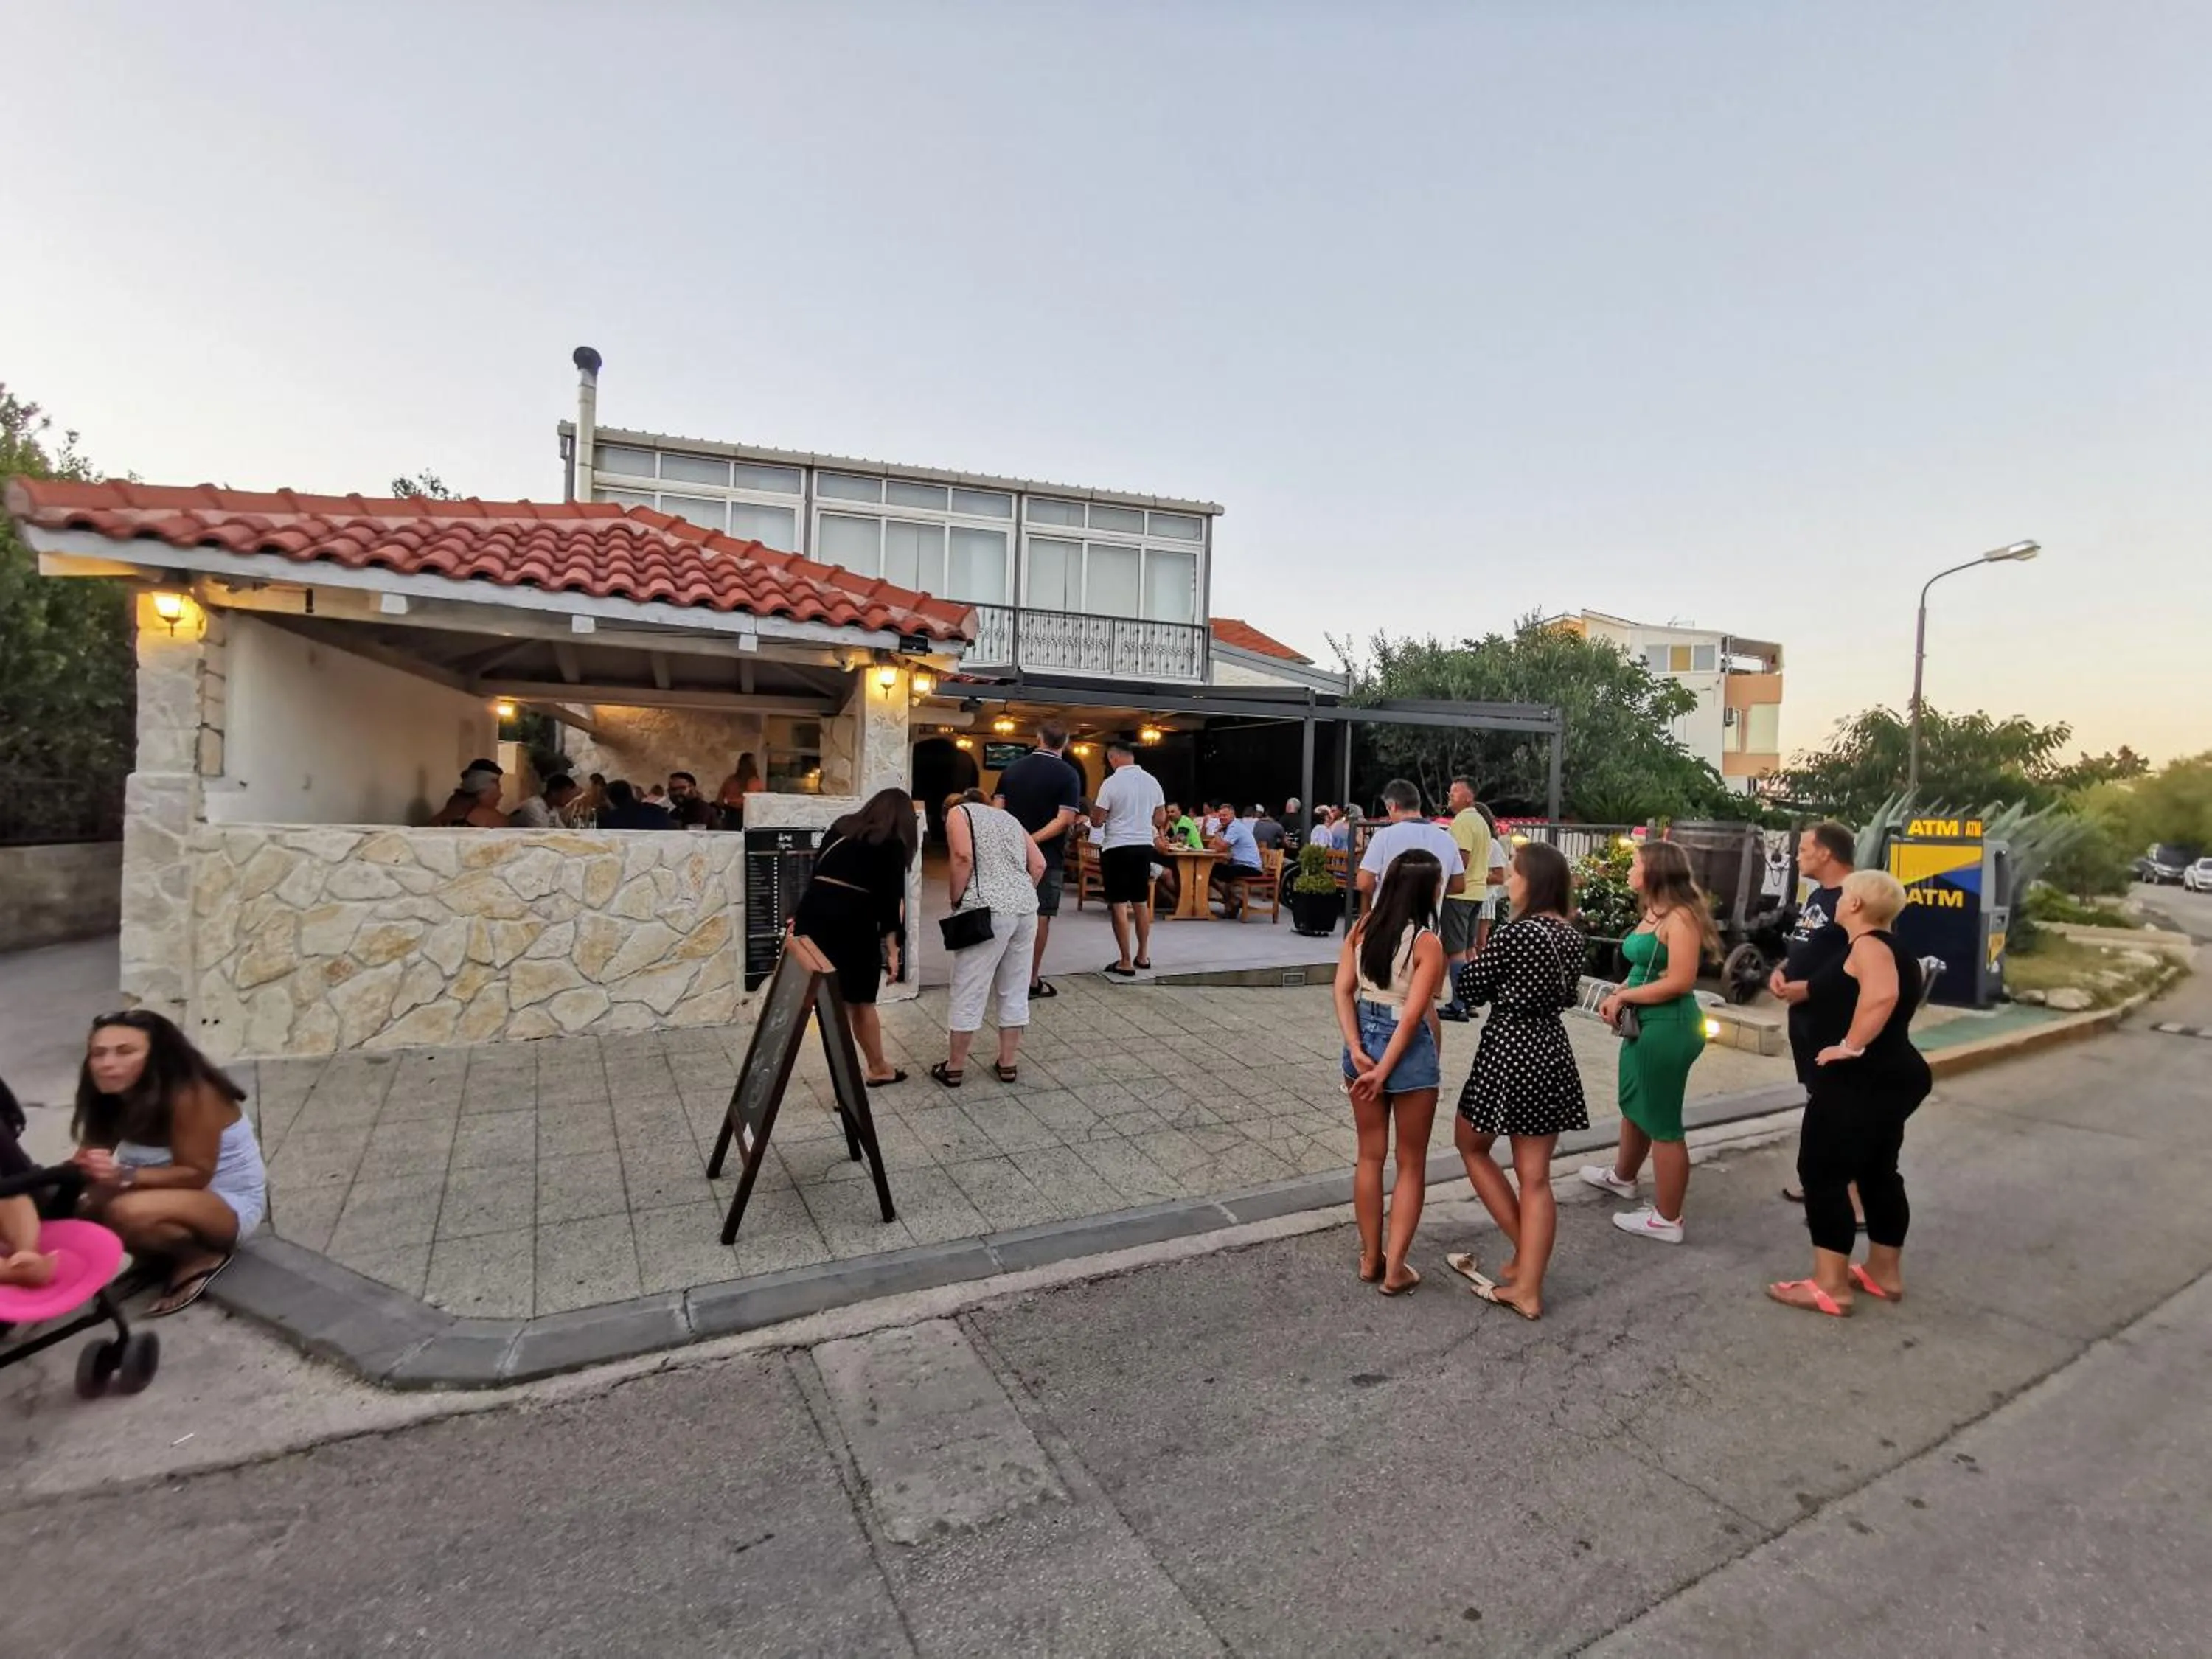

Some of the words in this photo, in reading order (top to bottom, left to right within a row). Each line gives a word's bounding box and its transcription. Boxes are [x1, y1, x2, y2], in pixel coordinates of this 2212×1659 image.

[1907, 819, 1958, 836] ATM
[1965, 820, 1982, 837] ATM
[1907, 888, 1964, 907] ATM
